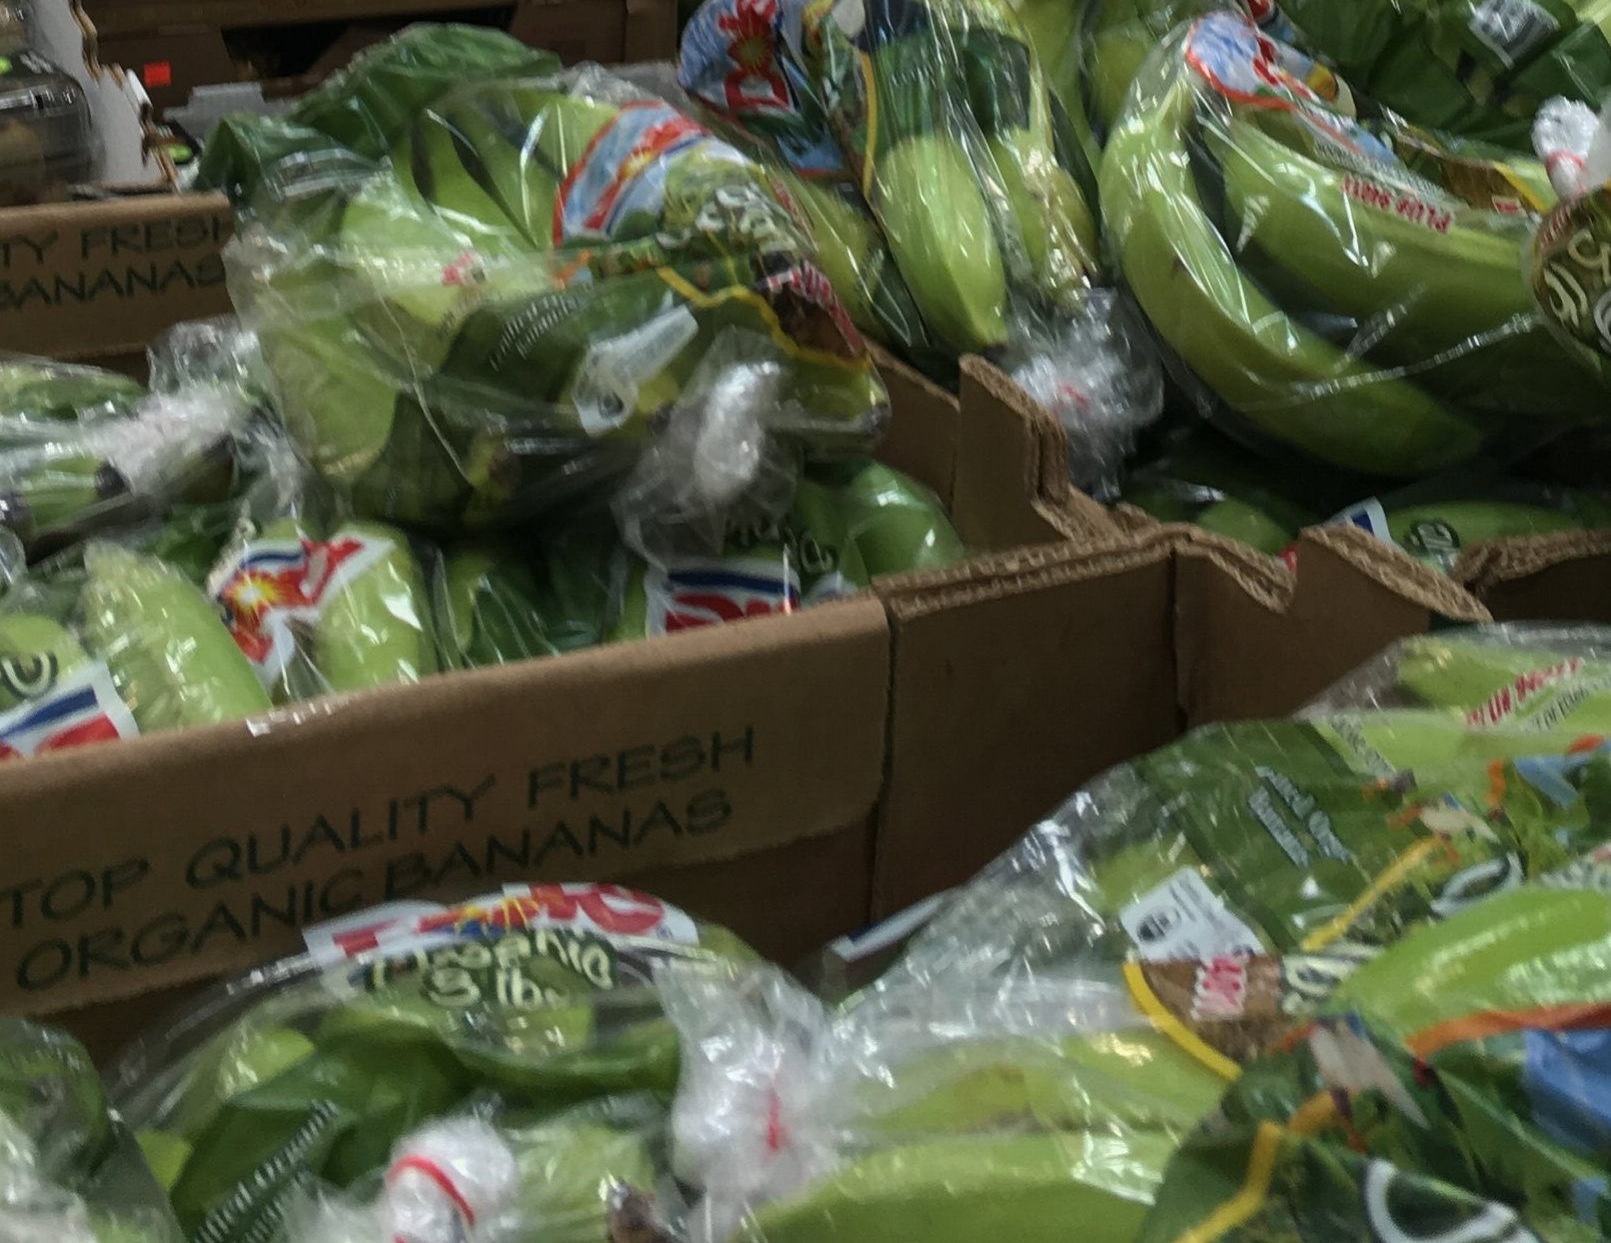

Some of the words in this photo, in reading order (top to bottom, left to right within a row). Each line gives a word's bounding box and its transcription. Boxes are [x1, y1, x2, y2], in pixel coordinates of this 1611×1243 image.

[1, 857, 150, 929] TOP
[184, 772, 497, 891] QUALITY
[528, 724, 755, 811] FRESH
[15, 864, 366, 993] ORGANIC
[384, 786, 733, 902] BANANAS
